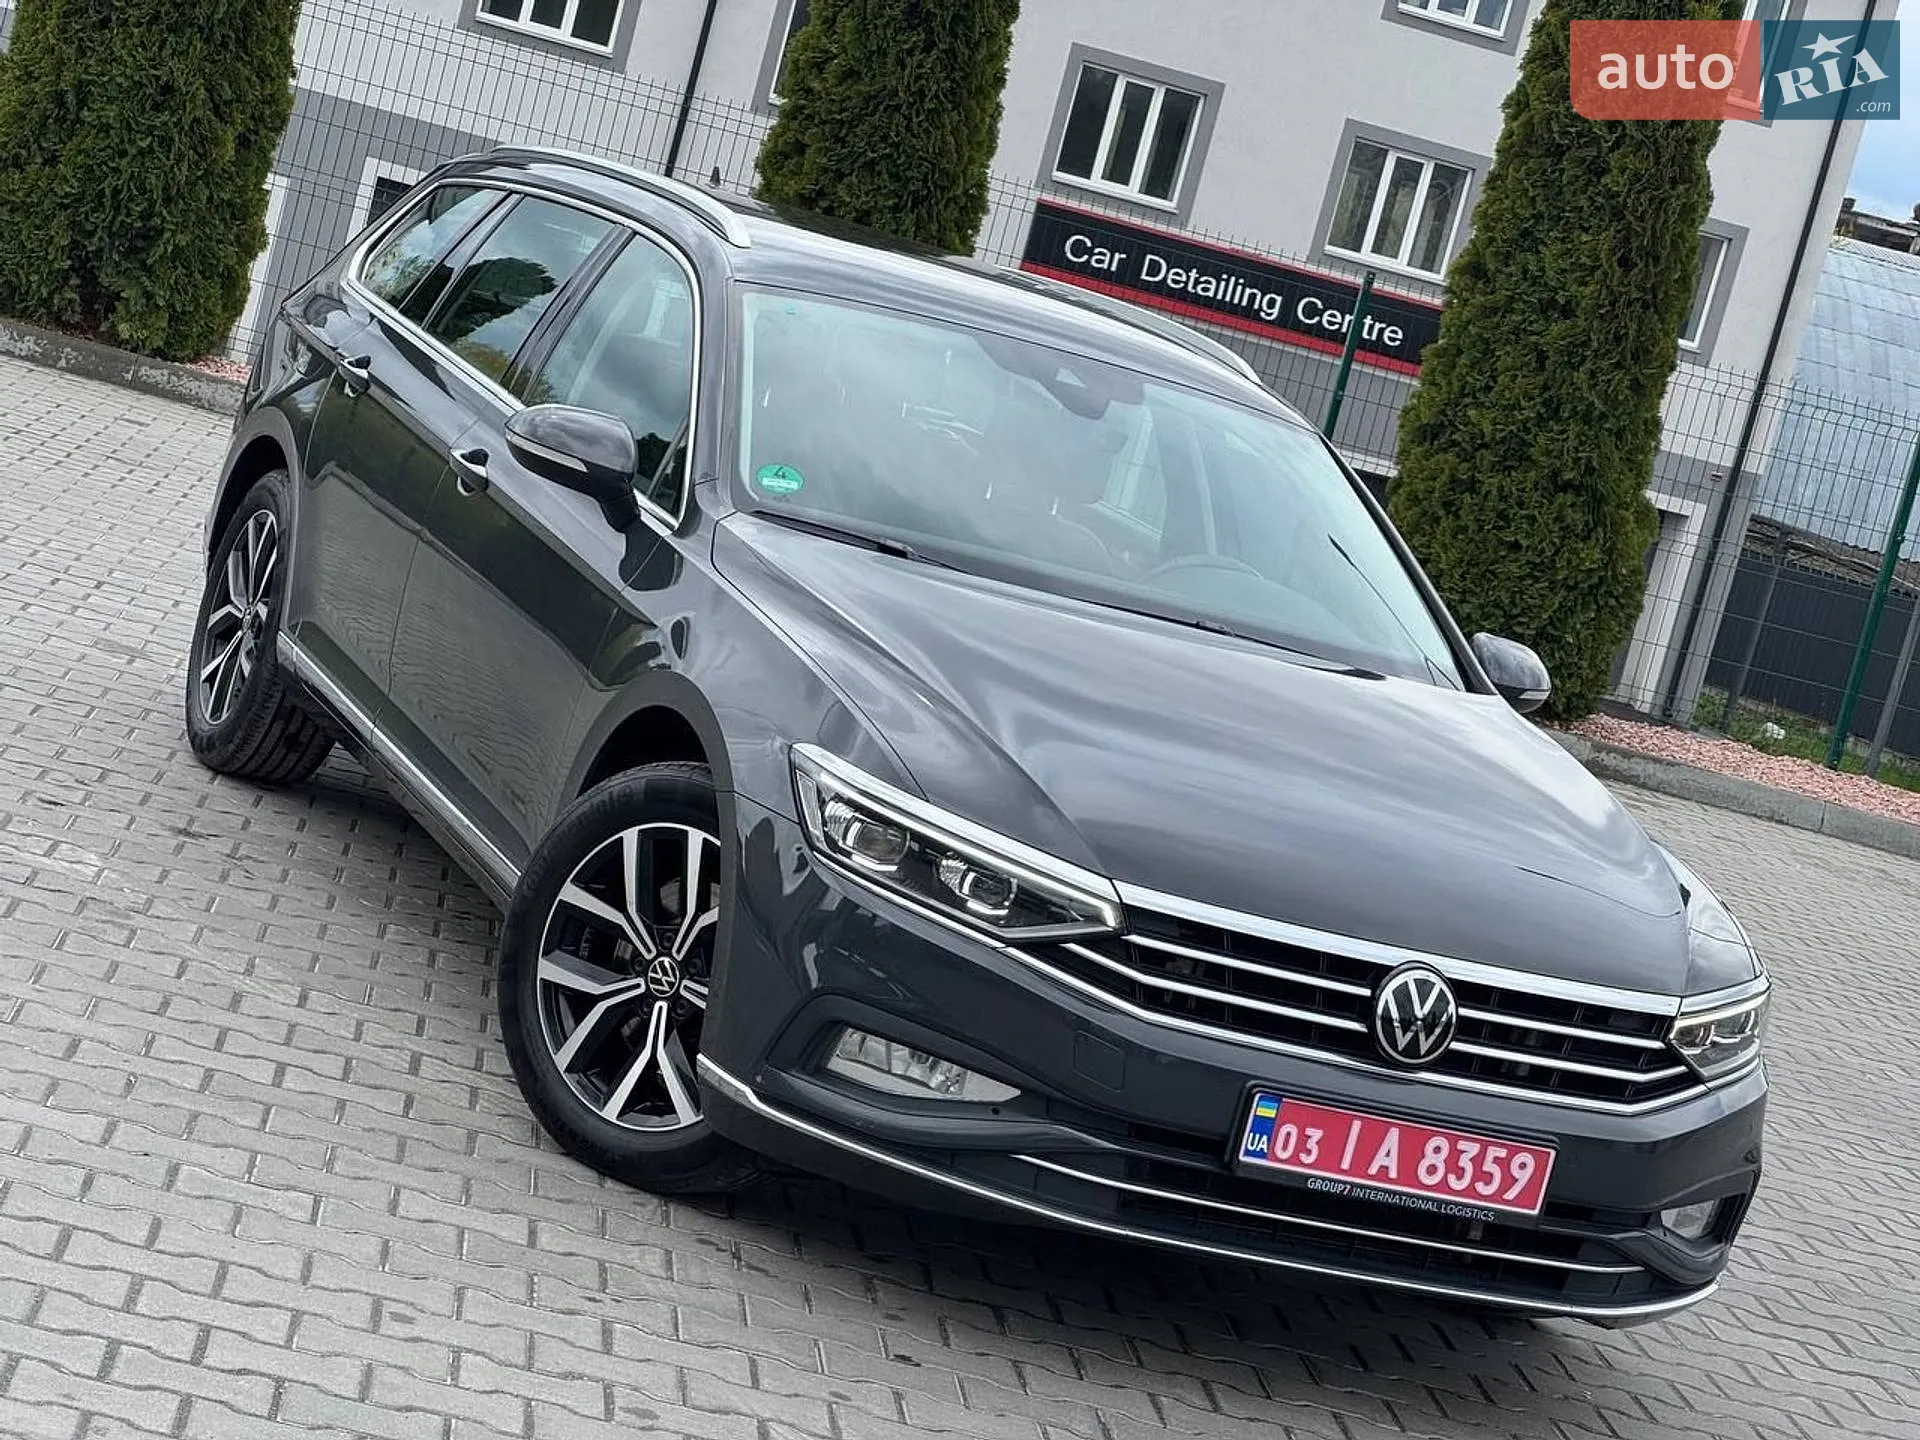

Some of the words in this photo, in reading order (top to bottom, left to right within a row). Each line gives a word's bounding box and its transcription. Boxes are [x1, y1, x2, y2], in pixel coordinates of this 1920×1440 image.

[1064, 234, 1127, 272] Car
[1140, 254, 1283, 320] Detailing
[1247, 1131, 1269, 1153] UA
[1273, 1123, 1324, 1165] 03
[1340, 1120, 1400, 1179] IA
[1417, 1136, 1536, 1201] 8359
[1307, 1177, 1351, 1196] GROUP7
[1351, 1187, 1439, 1212] INTERNATIONAL
[1440, 1204, 1496, 1222] LOGISTICS
